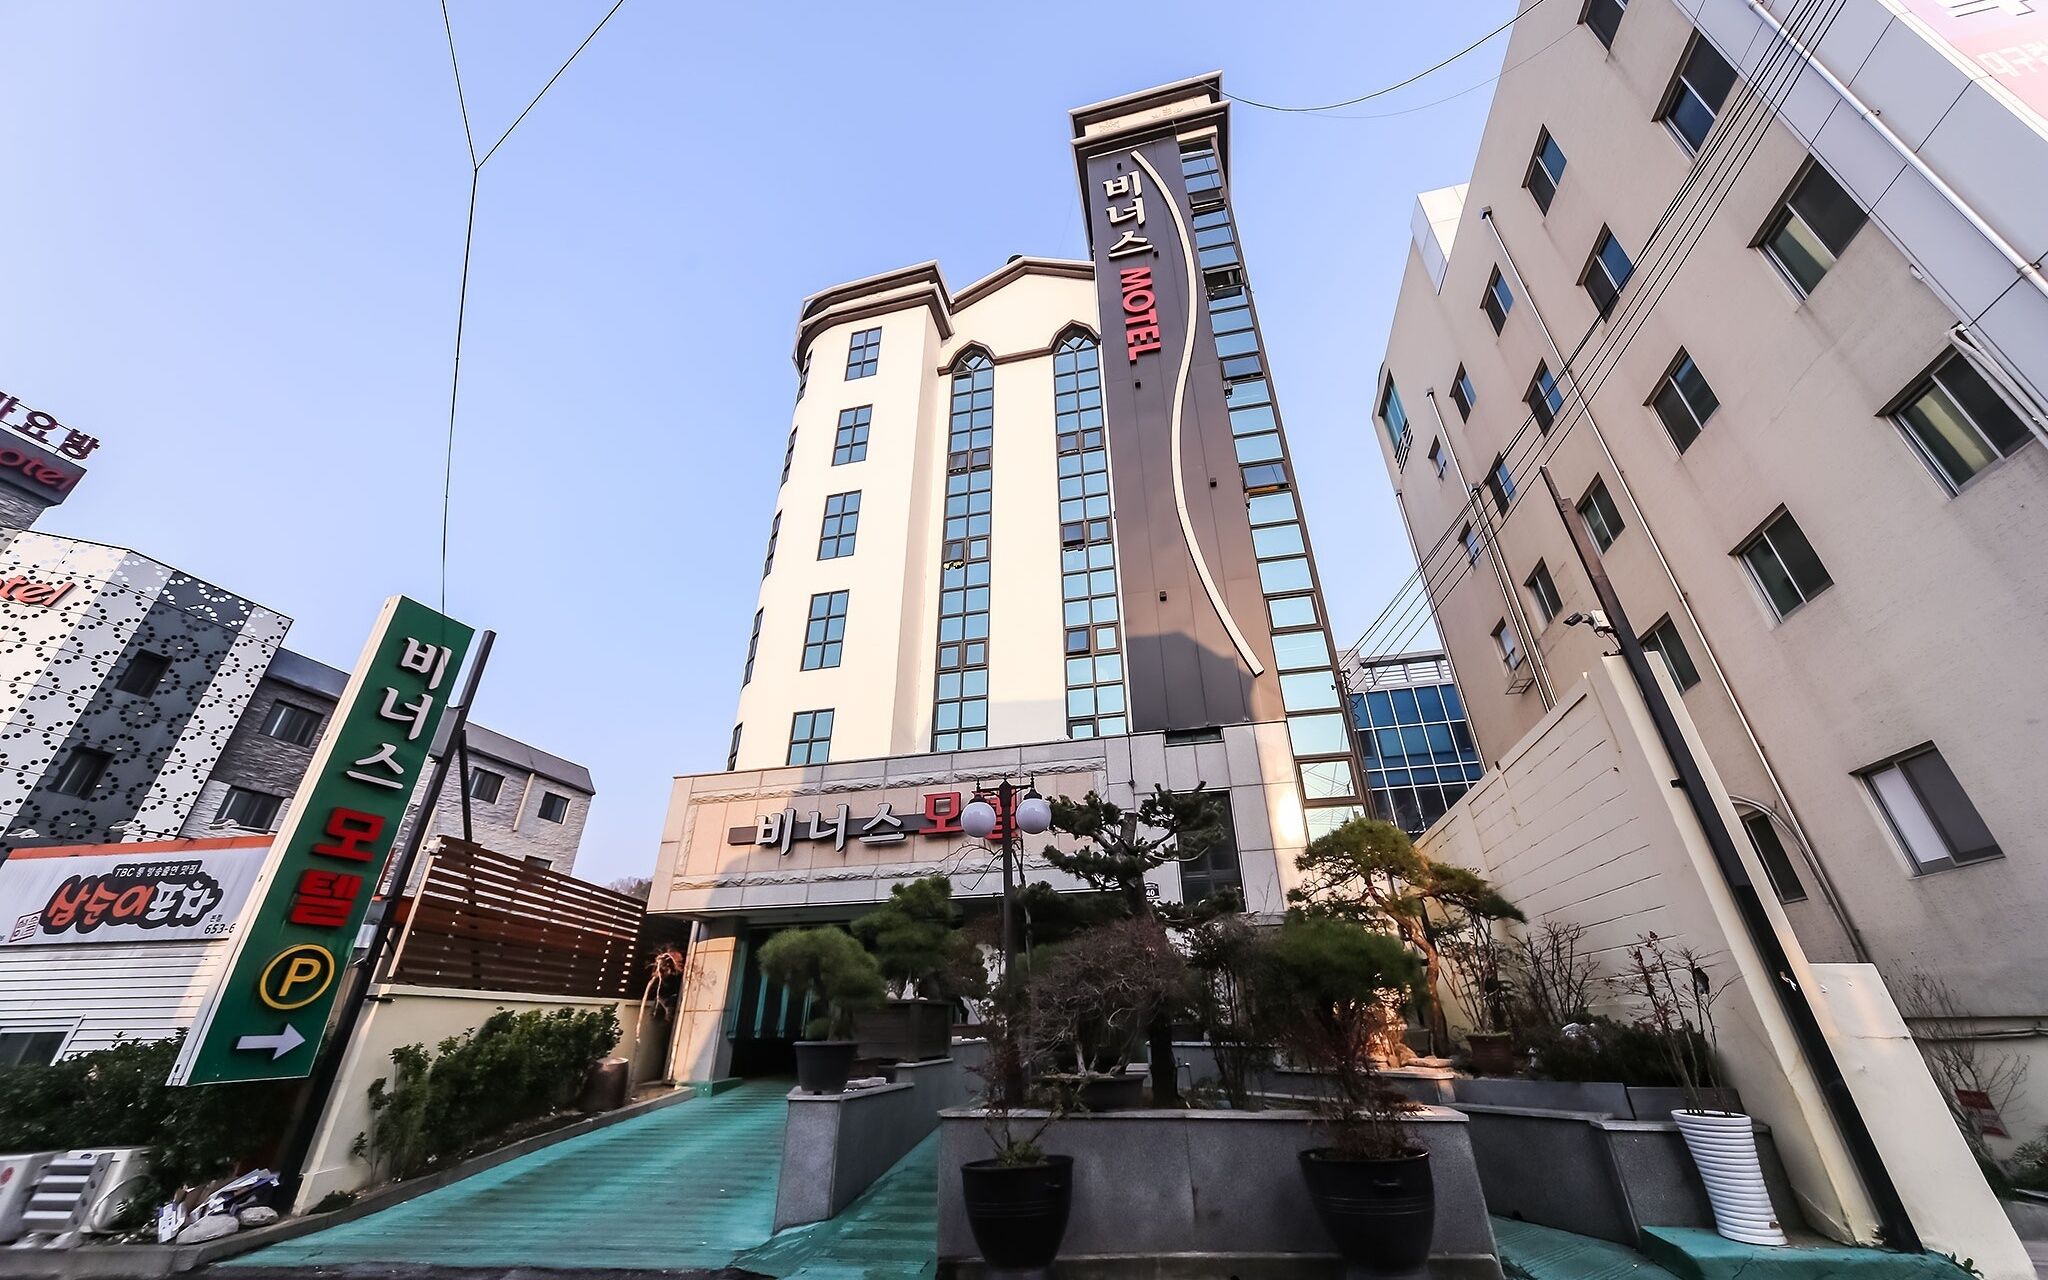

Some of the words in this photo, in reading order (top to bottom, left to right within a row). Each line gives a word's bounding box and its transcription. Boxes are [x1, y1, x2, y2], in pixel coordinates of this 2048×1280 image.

[1103, 170, 1153, 259] 비너스
[1120, 266, 1161, 363] MOTEL
[347, 636, 452, 790] 비너스
[115, 868, 135, 878] TBC
[290, 806, 386, 927] 모텔
[756, 803, 905, 855] 비너스
